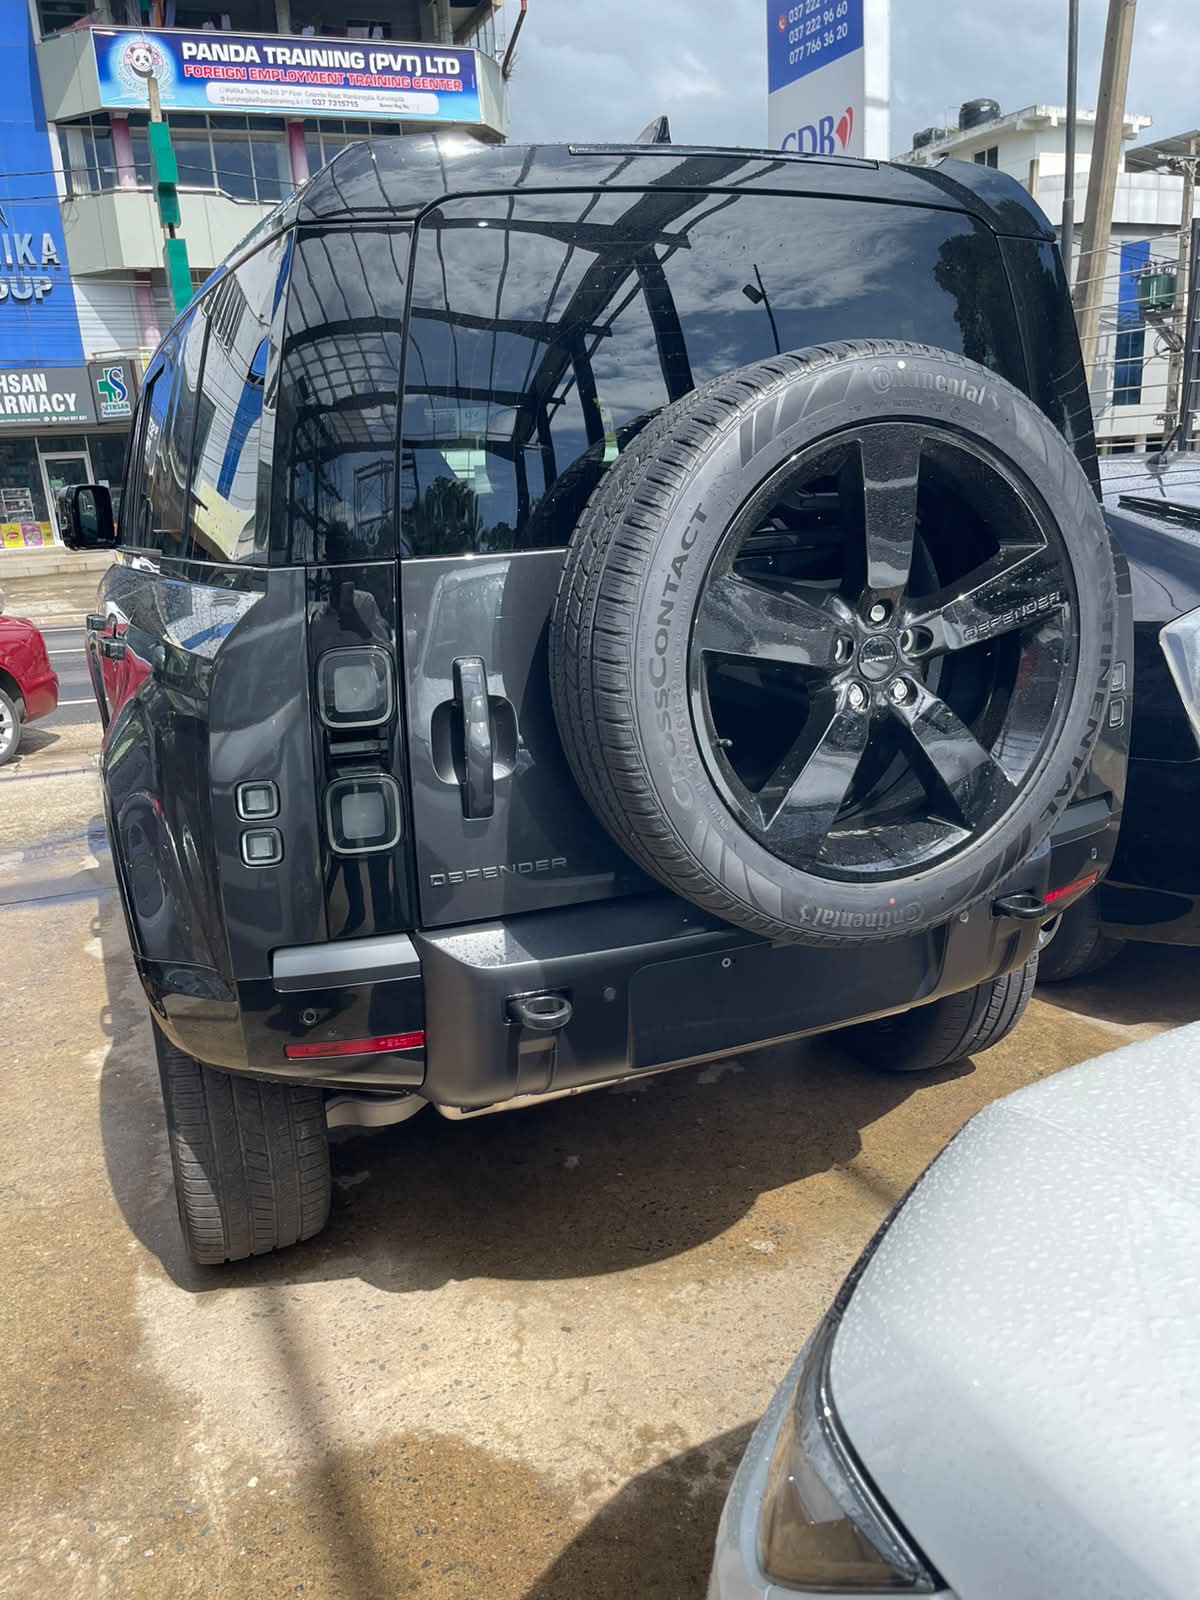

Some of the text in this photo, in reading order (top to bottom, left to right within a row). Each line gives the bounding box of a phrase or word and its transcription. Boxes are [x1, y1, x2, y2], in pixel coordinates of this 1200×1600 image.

[788, 3, 804, 23] 037
[788, 0, 848, 44] 037 222 96 60
[181, 42, 460, 76] PANDA TRAINING (PVT) LTD
[788, 22, 848, 64] 077 766 36 20
[183, 65, 462, 91] FOREIGN EMPLOYMENT TRAINING CENTER
[312, 98, 326, 106] 037
[0, 232, 61, 265] IKA
[963, 591, 1060, 641] DEFENDER
[430, 857, 567, 886] DEFENDER
